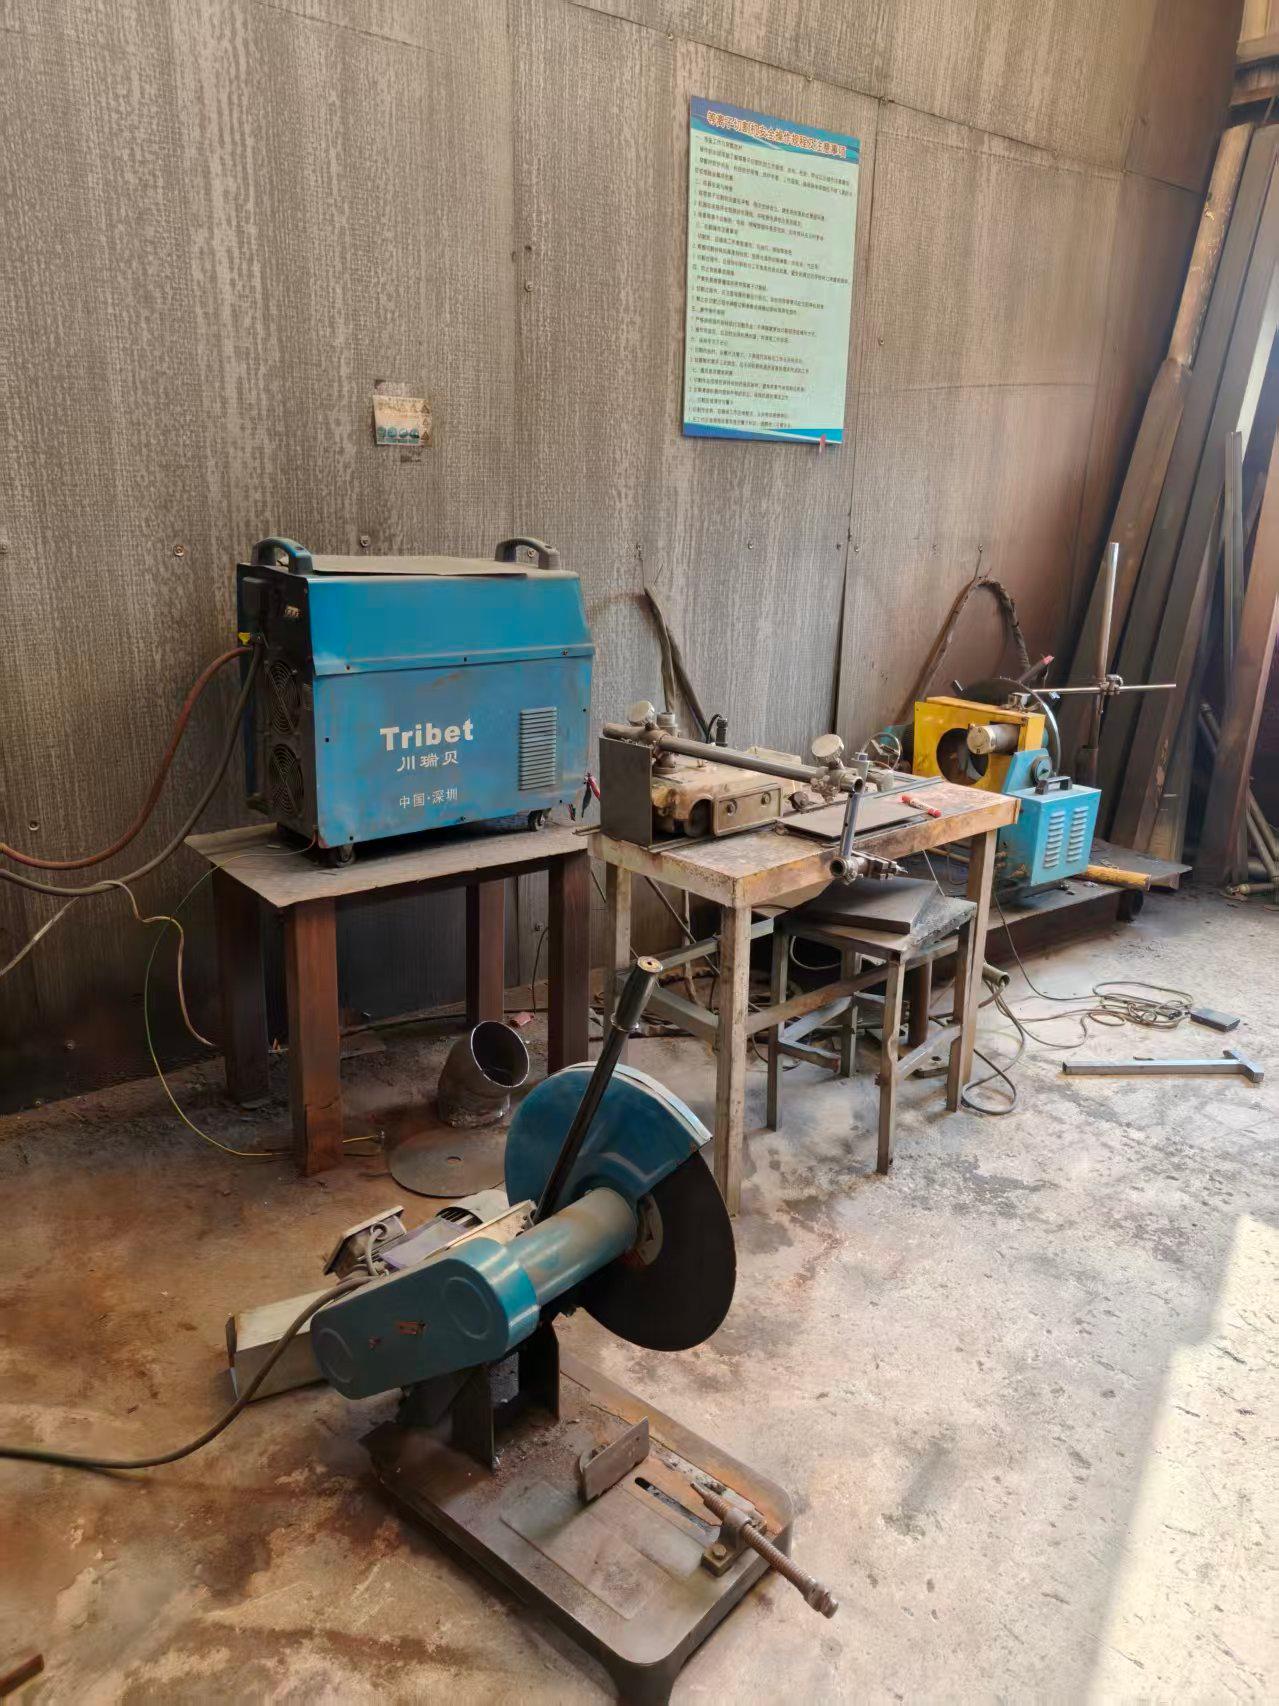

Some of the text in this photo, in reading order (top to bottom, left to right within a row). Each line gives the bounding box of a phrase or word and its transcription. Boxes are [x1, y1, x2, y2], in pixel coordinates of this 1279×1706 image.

[379, 718, 474, 751] Tribet
[396, 750, 459, 772] 川瑞贝
[399, 787, 458, 809] 中国·深圳
